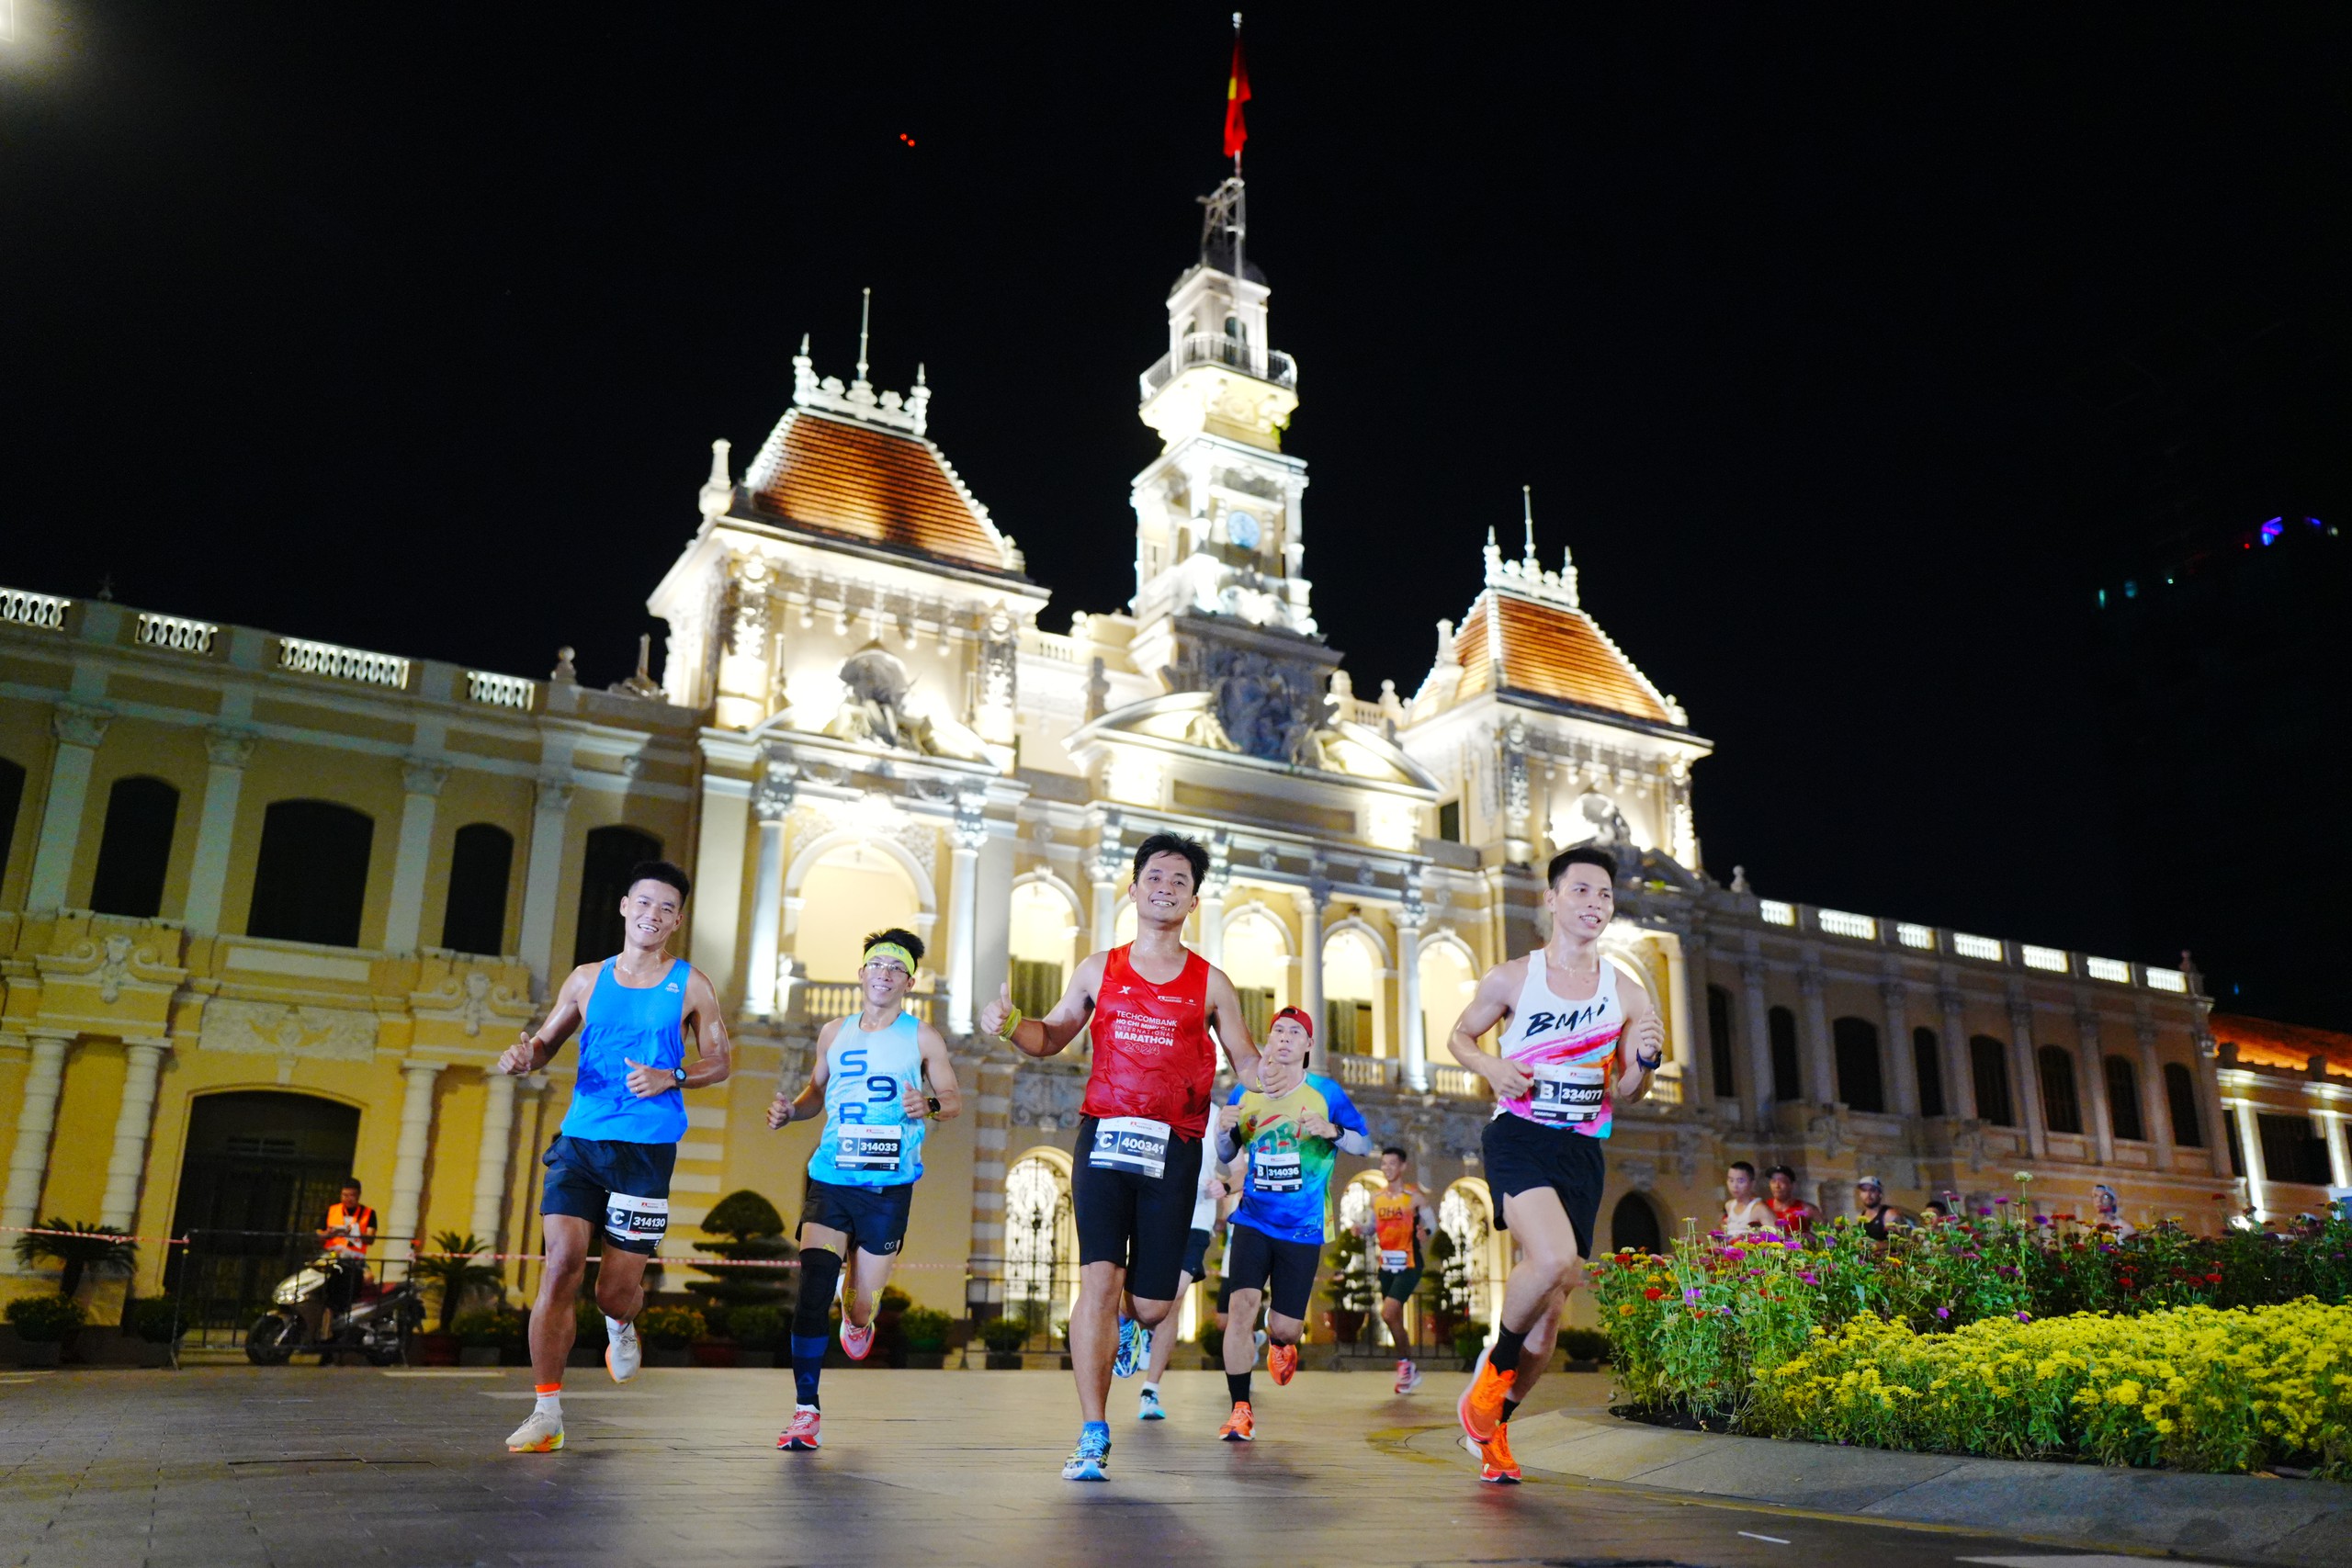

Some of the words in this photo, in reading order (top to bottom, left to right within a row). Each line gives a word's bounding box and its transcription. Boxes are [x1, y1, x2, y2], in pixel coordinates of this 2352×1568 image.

[1116, 1010, 1178, 1027] TECHCOMBANK
[1114, 1025, 1175, 1038] INTERNATIONAL
[1114, 1031, 1173, 1046] MARATHON
[1125, 1041, 1160, 1055] 2024
[840, 1049, 868, 1078] S
[1539, 1084, 1555, 1100] B
[1562, 1088, 1603, 1100] 334077
[842, 1139, 854, 1152] C
[860, 1142, 899, 1152] 314033
[1099, 1133, 1114, 1148] C
[1121, 1137, 1165, 1155] 400341
[1257, 1166, 1264, 1177] B
[1268, 1167, 1300, 1176] 314036
[610, 1211, 625, 1224] C
[632, 1216, 666, 1227] 314130
